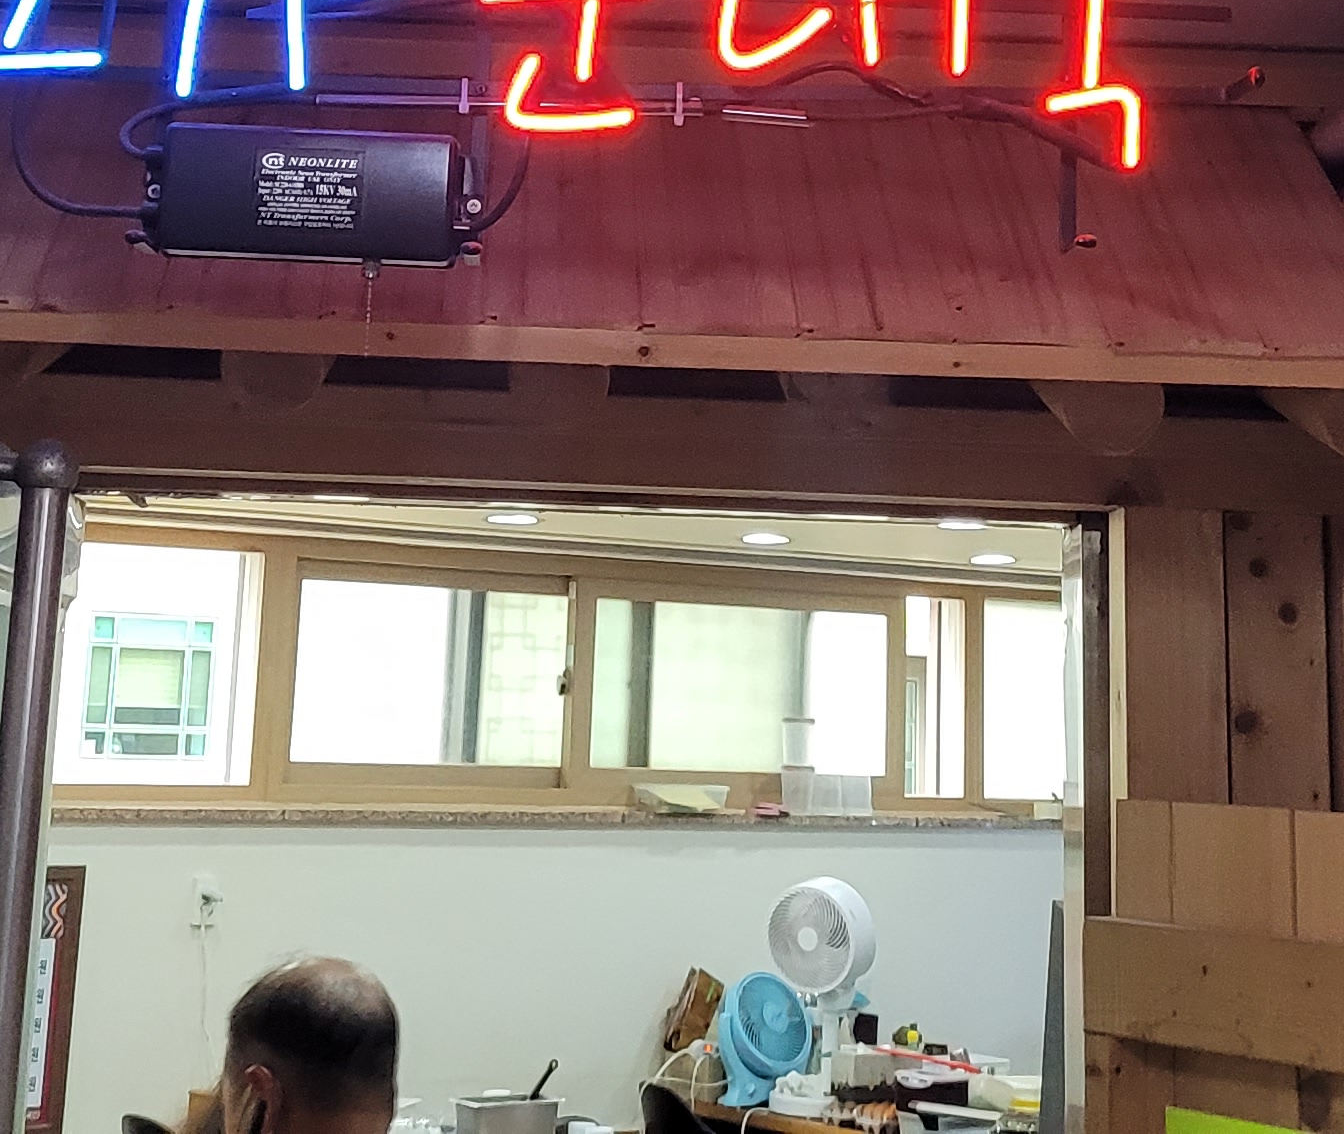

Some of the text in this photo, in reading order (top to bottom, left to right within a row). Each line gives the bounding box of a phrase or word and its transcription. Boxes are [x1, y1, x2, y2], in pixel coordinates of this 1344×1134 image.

[287, 156, 358, 168] NEONLITE
[261, 194, 296, 202] DANGER
[273, 212, 329, 221] Transformers
